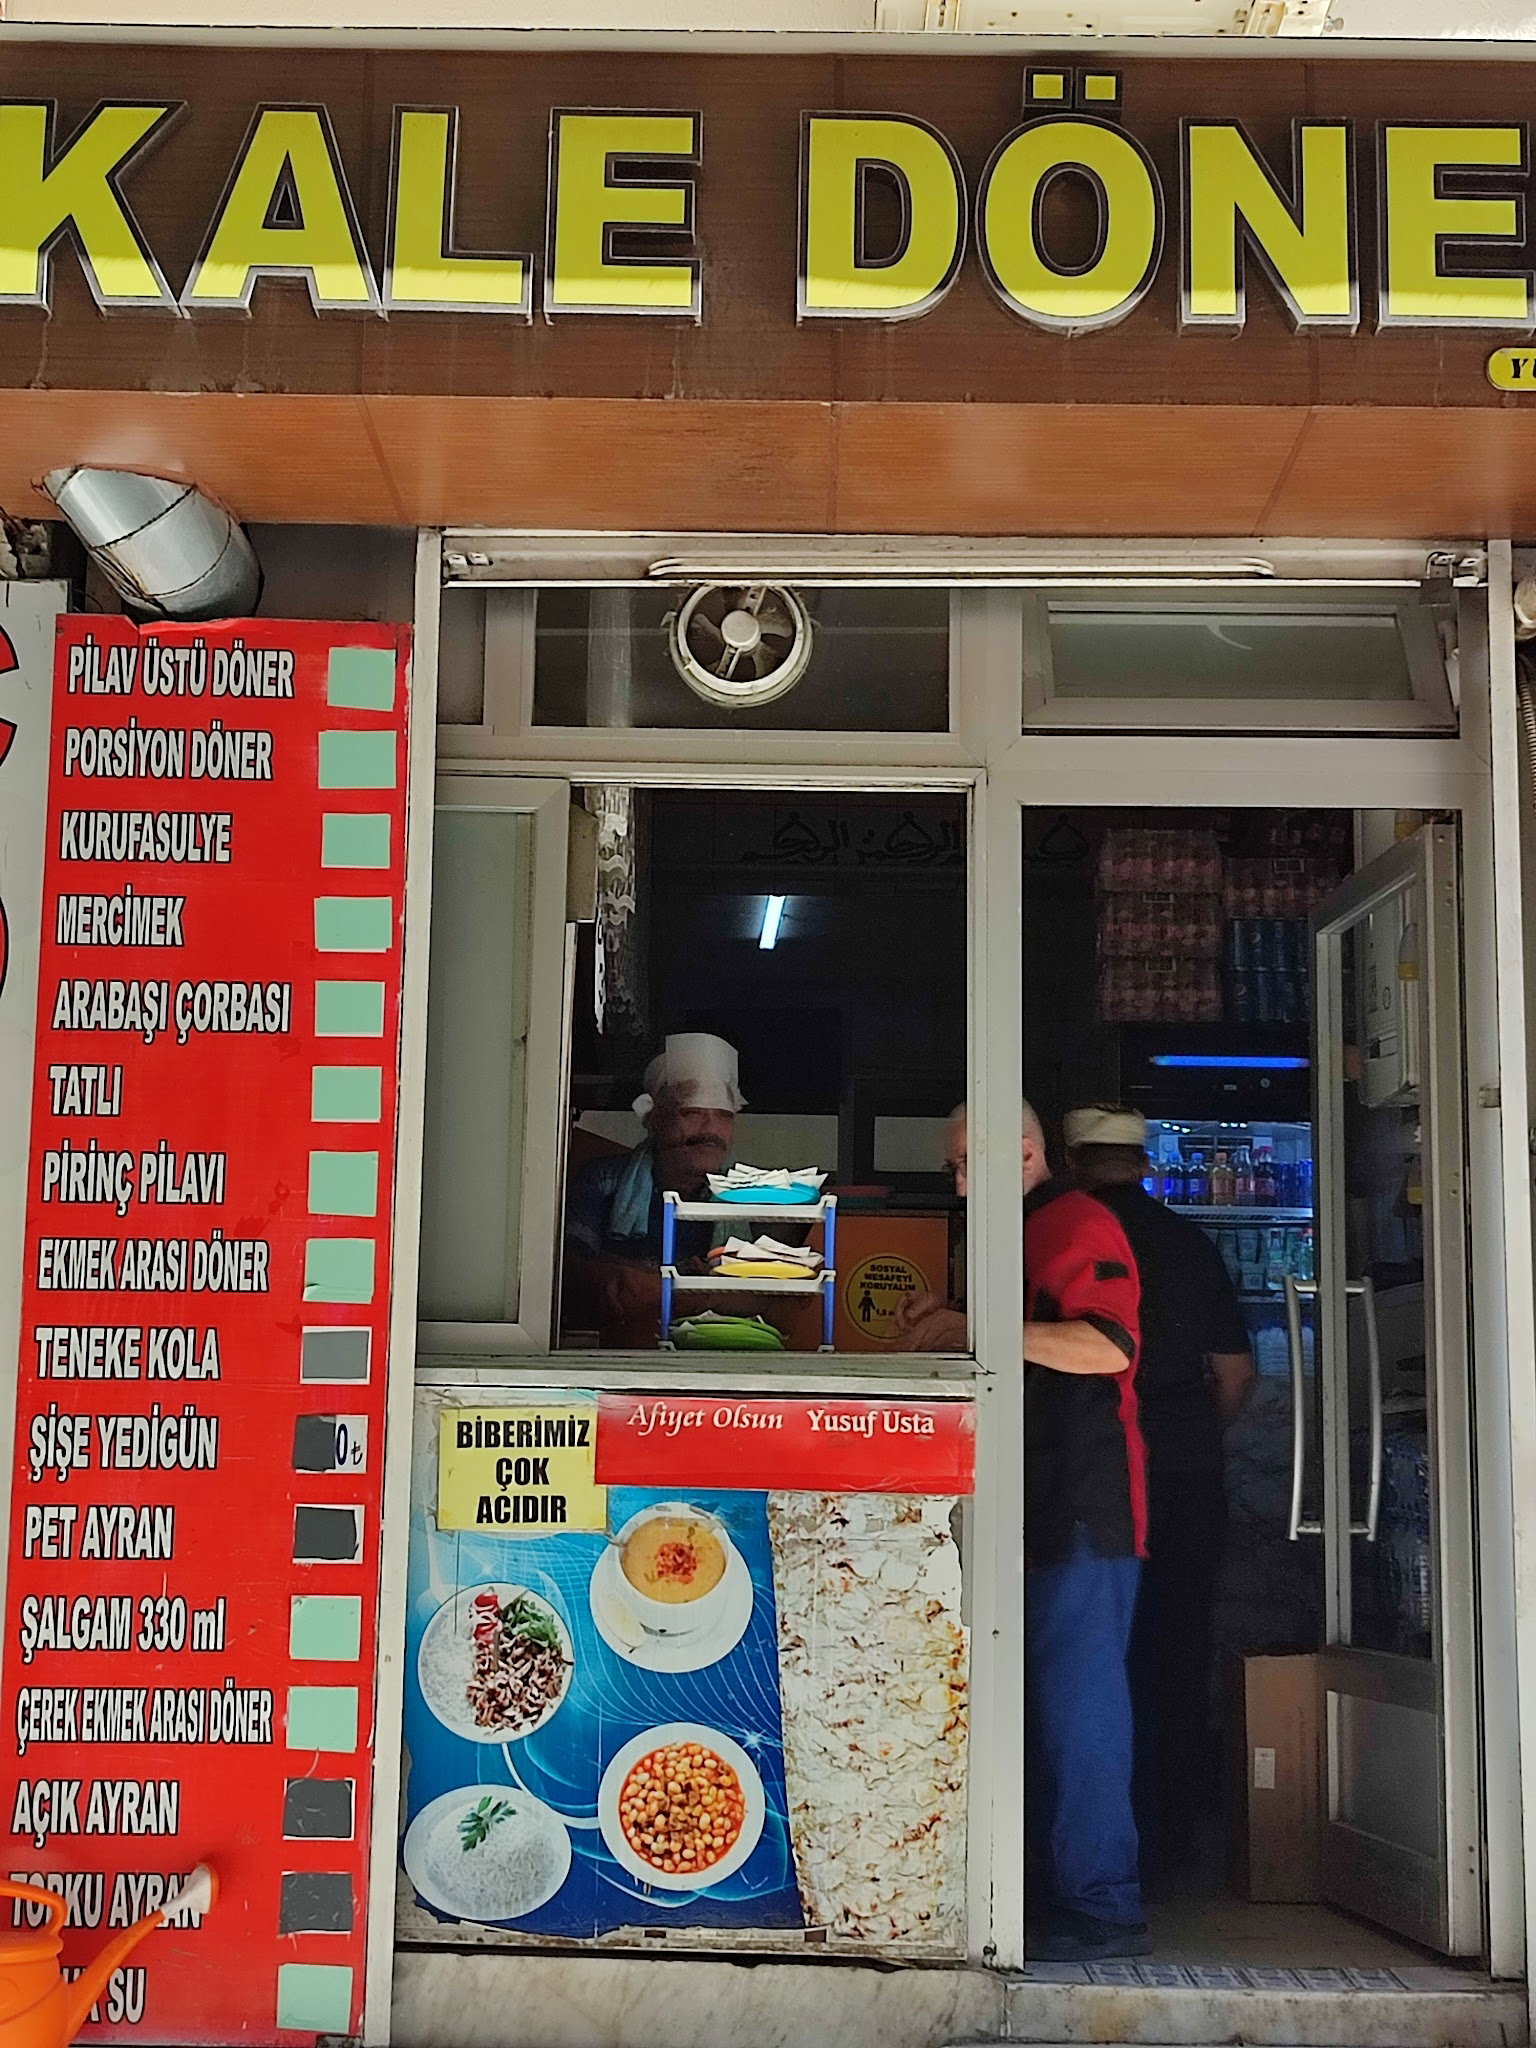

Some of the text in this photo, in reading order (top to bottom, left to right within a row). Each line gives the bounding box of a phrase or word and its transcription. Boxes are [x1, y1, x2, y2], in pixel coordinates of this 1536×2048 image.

[0, 97, 703, 322] KALE
[68, 633, 294, 699] PİLAV ÜSTÜ DÖNER
[64, 716, 273, 780] PORSİYON DÖNER
[60, 810, 232, 863] KURUFASULYE
[56, 883, 185, 947] MERCİMEK
[51, 979, 291, 1045] ARABAŞI ÇORBASI
[48, 1064, 122, 1116] TATLI
[42, 1138, 226, 1217] PİRİNÇ PİLAVI
[37, 1228, 269, 1293] EKMEK ARASI DÖNER
[34, 1326, 220, 1381] TENEKE KOLA
[28, 1402, 218, 1483] ŞİŞE YEDİGÜN
[456, 1414, 590, 1449] BİBERİMİZ
[627, 1400, 936, 1438] Afiyet Olsun Yusuf Usta
[495, 1457, 550, 1492] ÇOK
[23, 1505, 174, 1560] PET AYRAN
[476, 1495, 567, 1524] ACIDIR
[20, 1594, 226, 1665] ŞALGAM 330 ml
[16, 1677, 273, 1757] ÇEREK EKMEK ARASI DÖNER
[11, 1779, 179, 1849] AÇIK AYRAN
[106, 1967, 146, 2024] SU
